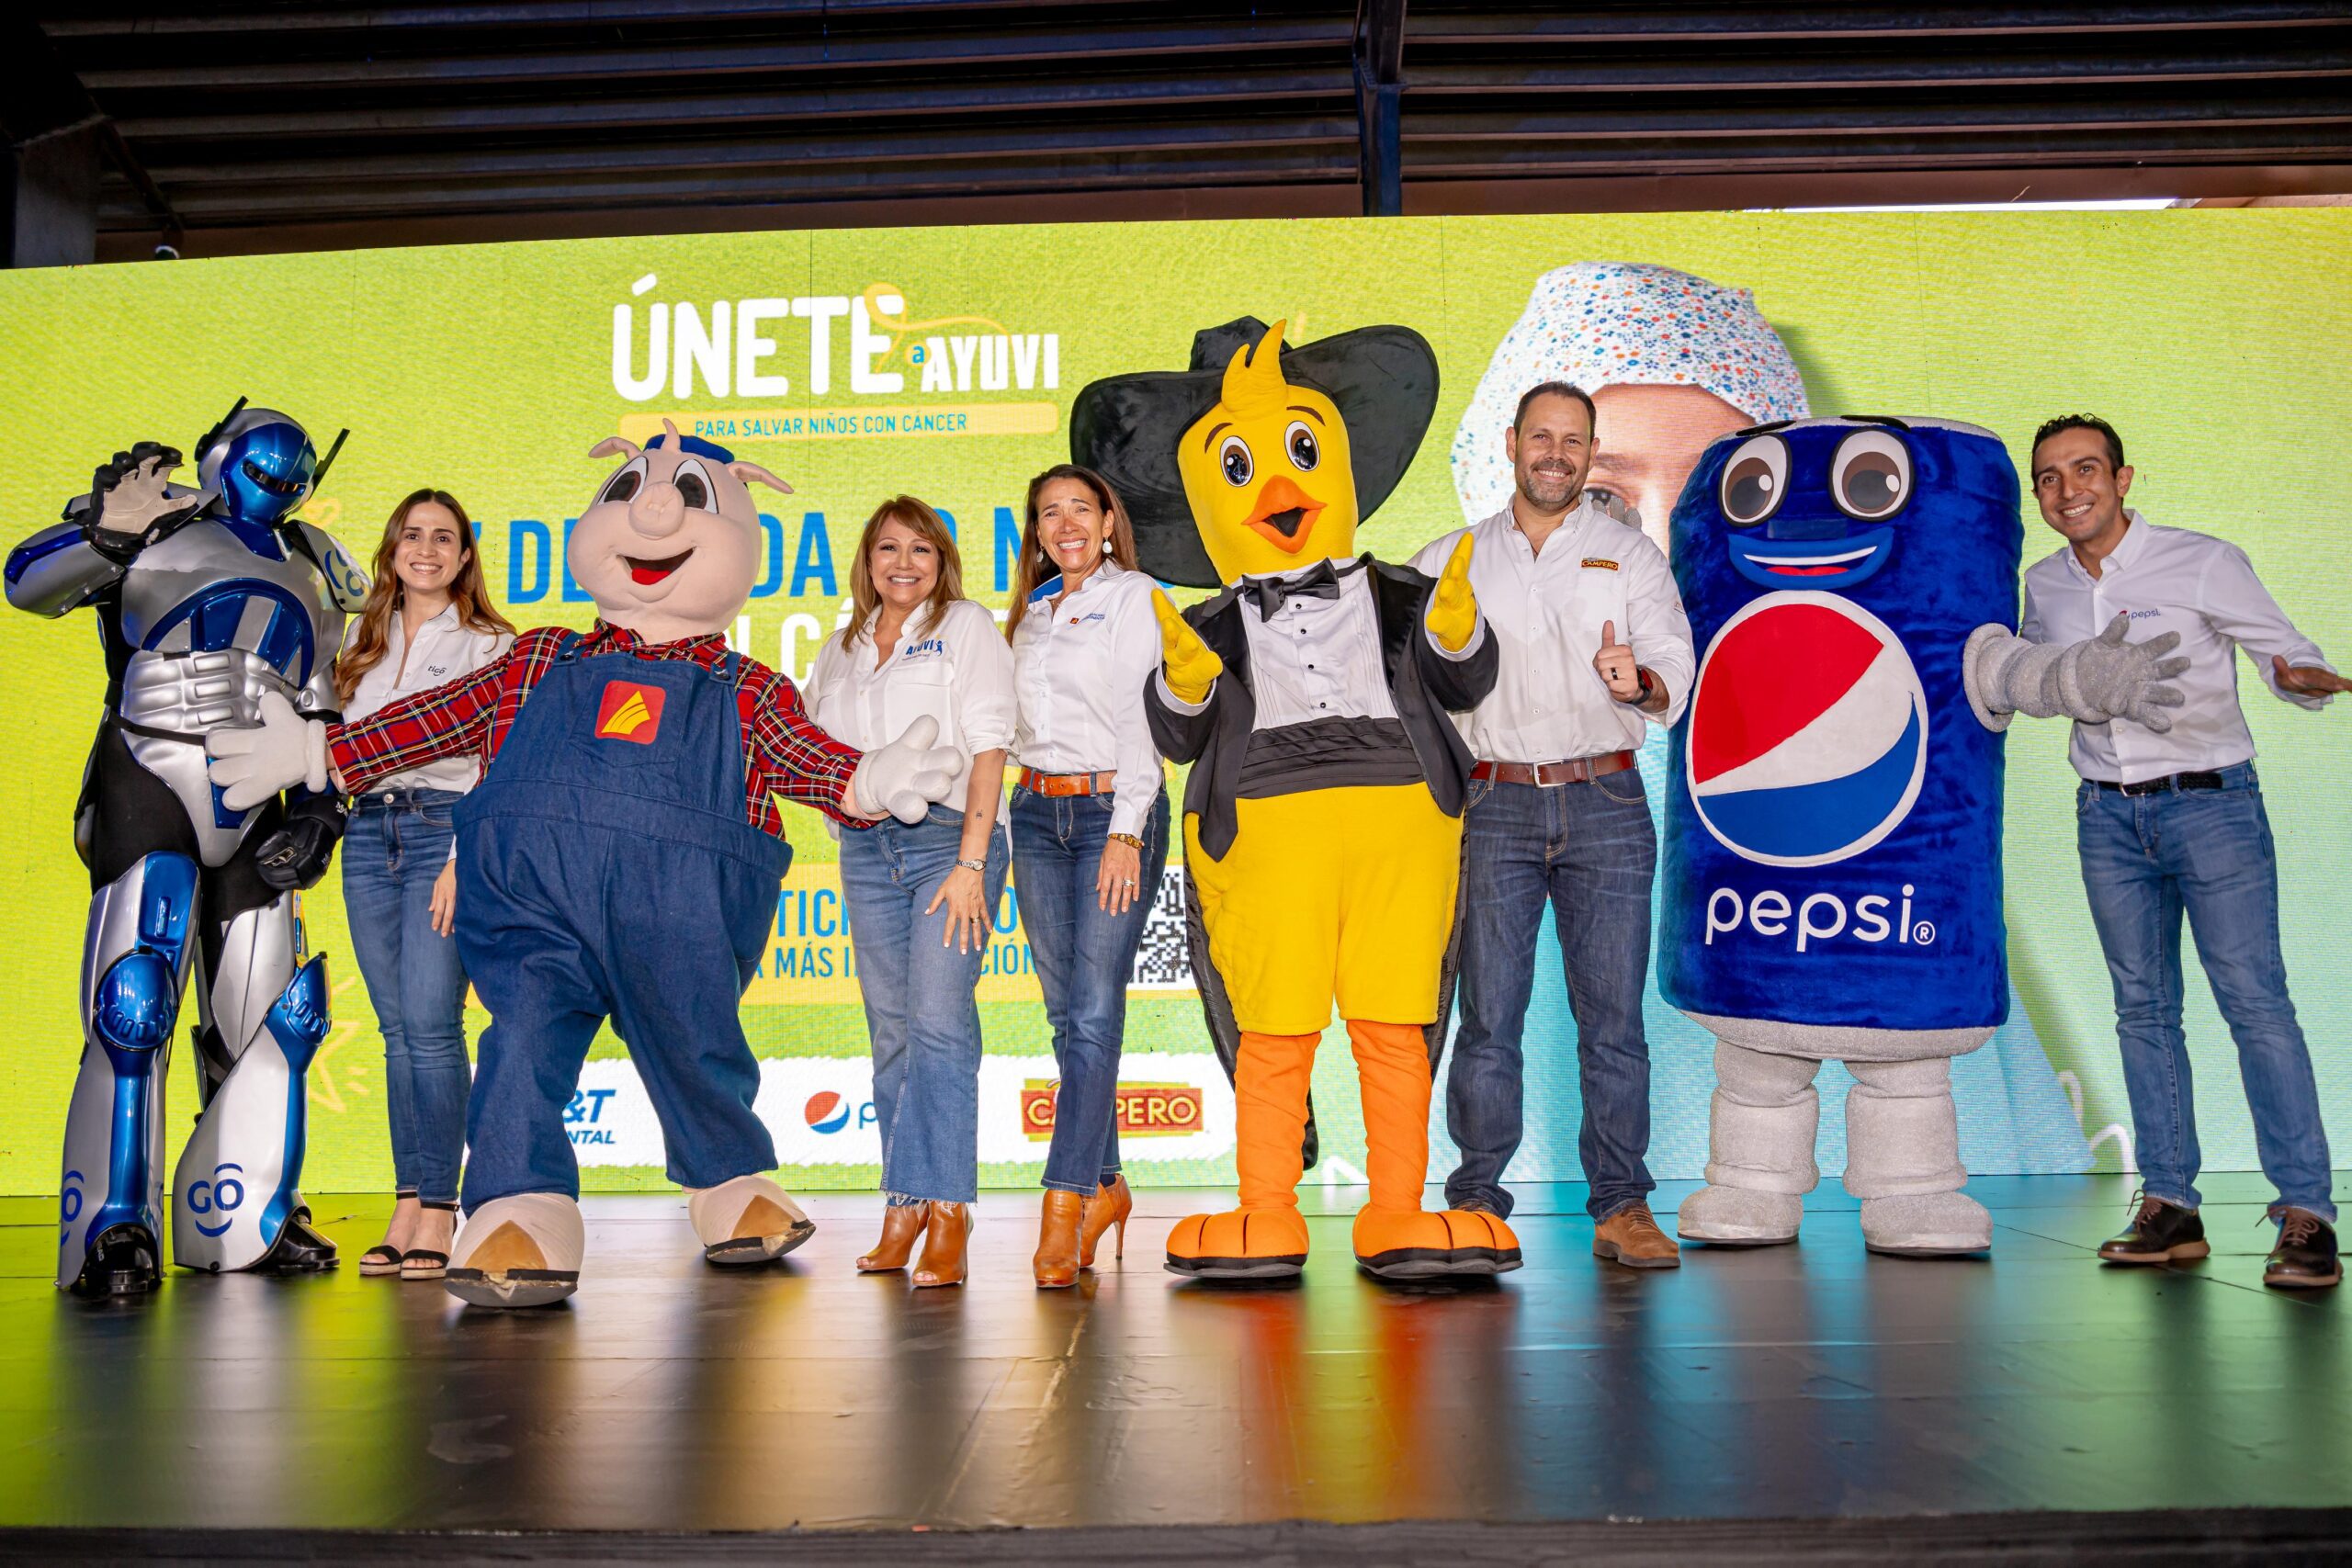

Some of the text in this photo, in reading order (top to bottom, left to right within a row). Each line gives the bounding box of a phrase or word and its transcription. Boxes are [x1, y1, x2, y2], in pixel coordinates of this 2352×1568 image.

[613, 273, 905, 402] ÚNETE
[911, 333, 1059, 392] a AYUVI
[695, 411, 967, 437] PARA SALVAR NIÑOS CON CÁNCER
[1582, 560, 1618, 570] CAMPERO
[775, 942, 834, 978] MÁS
[562, 1089, 617, 1123] &T
